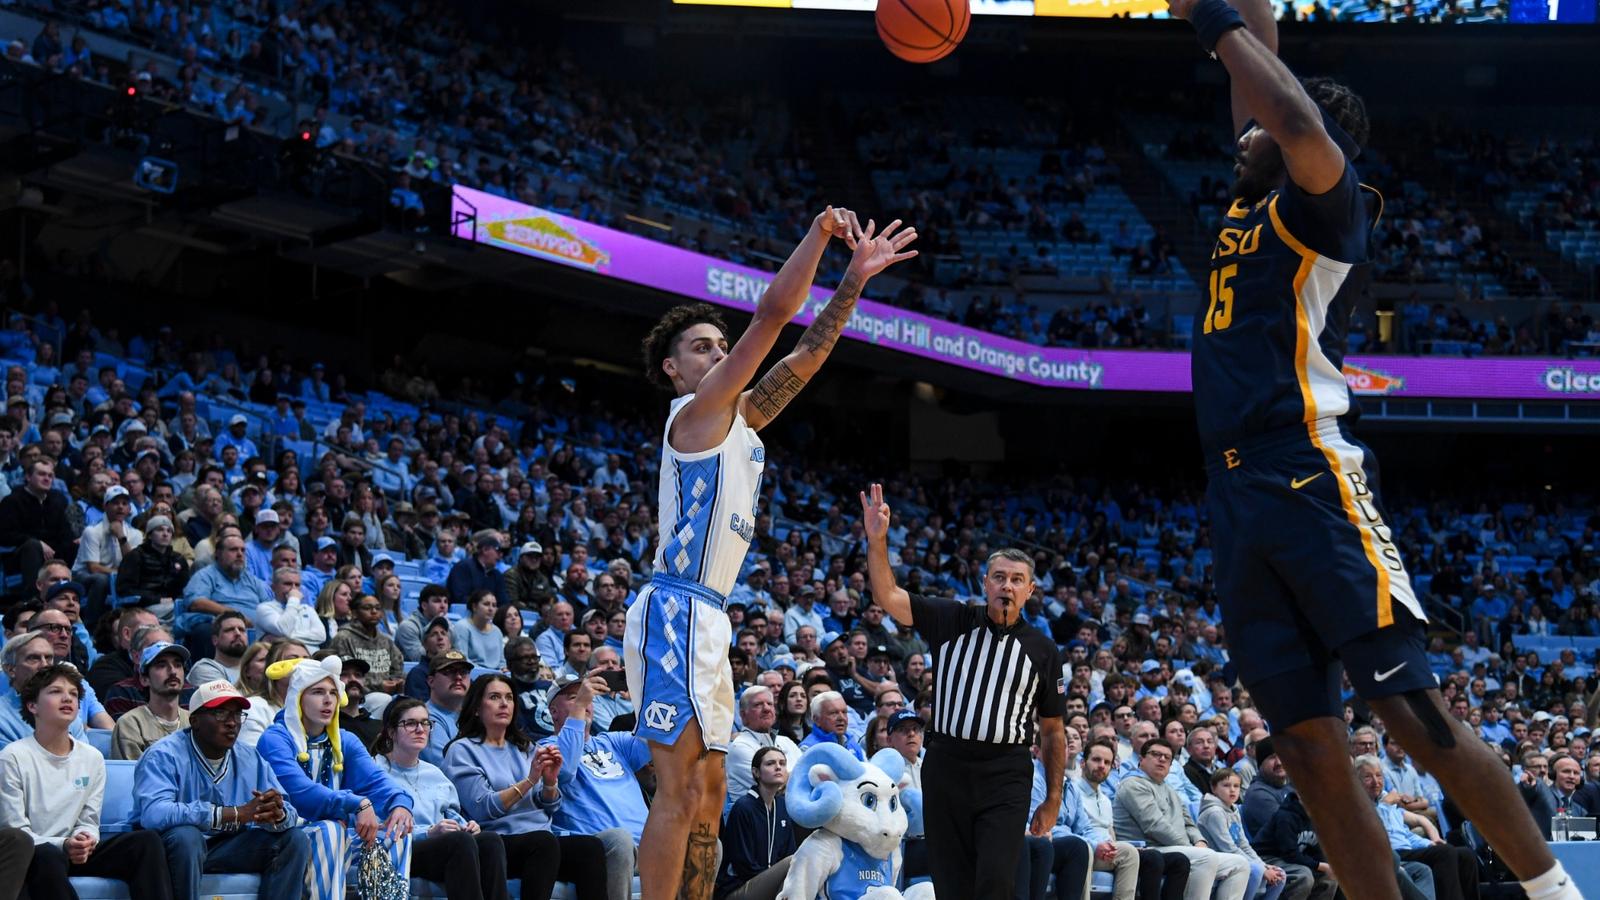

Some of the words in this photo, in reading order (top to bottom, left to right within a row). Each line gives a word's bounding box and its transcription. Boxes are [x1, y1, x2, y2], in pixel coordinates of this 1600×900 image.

[1211, 223, 1263, 259] SU
[1203, 263, 1238, 335] 15
[849, 306, 899, 342] hapel
[902, 322, 931, 348] Hill
[933, 334, 964, 358] and
[967, 340, 1026, 374] Orange
[1028, 356, 1101, 385] County
[1223, 448, 1242, 470] E
